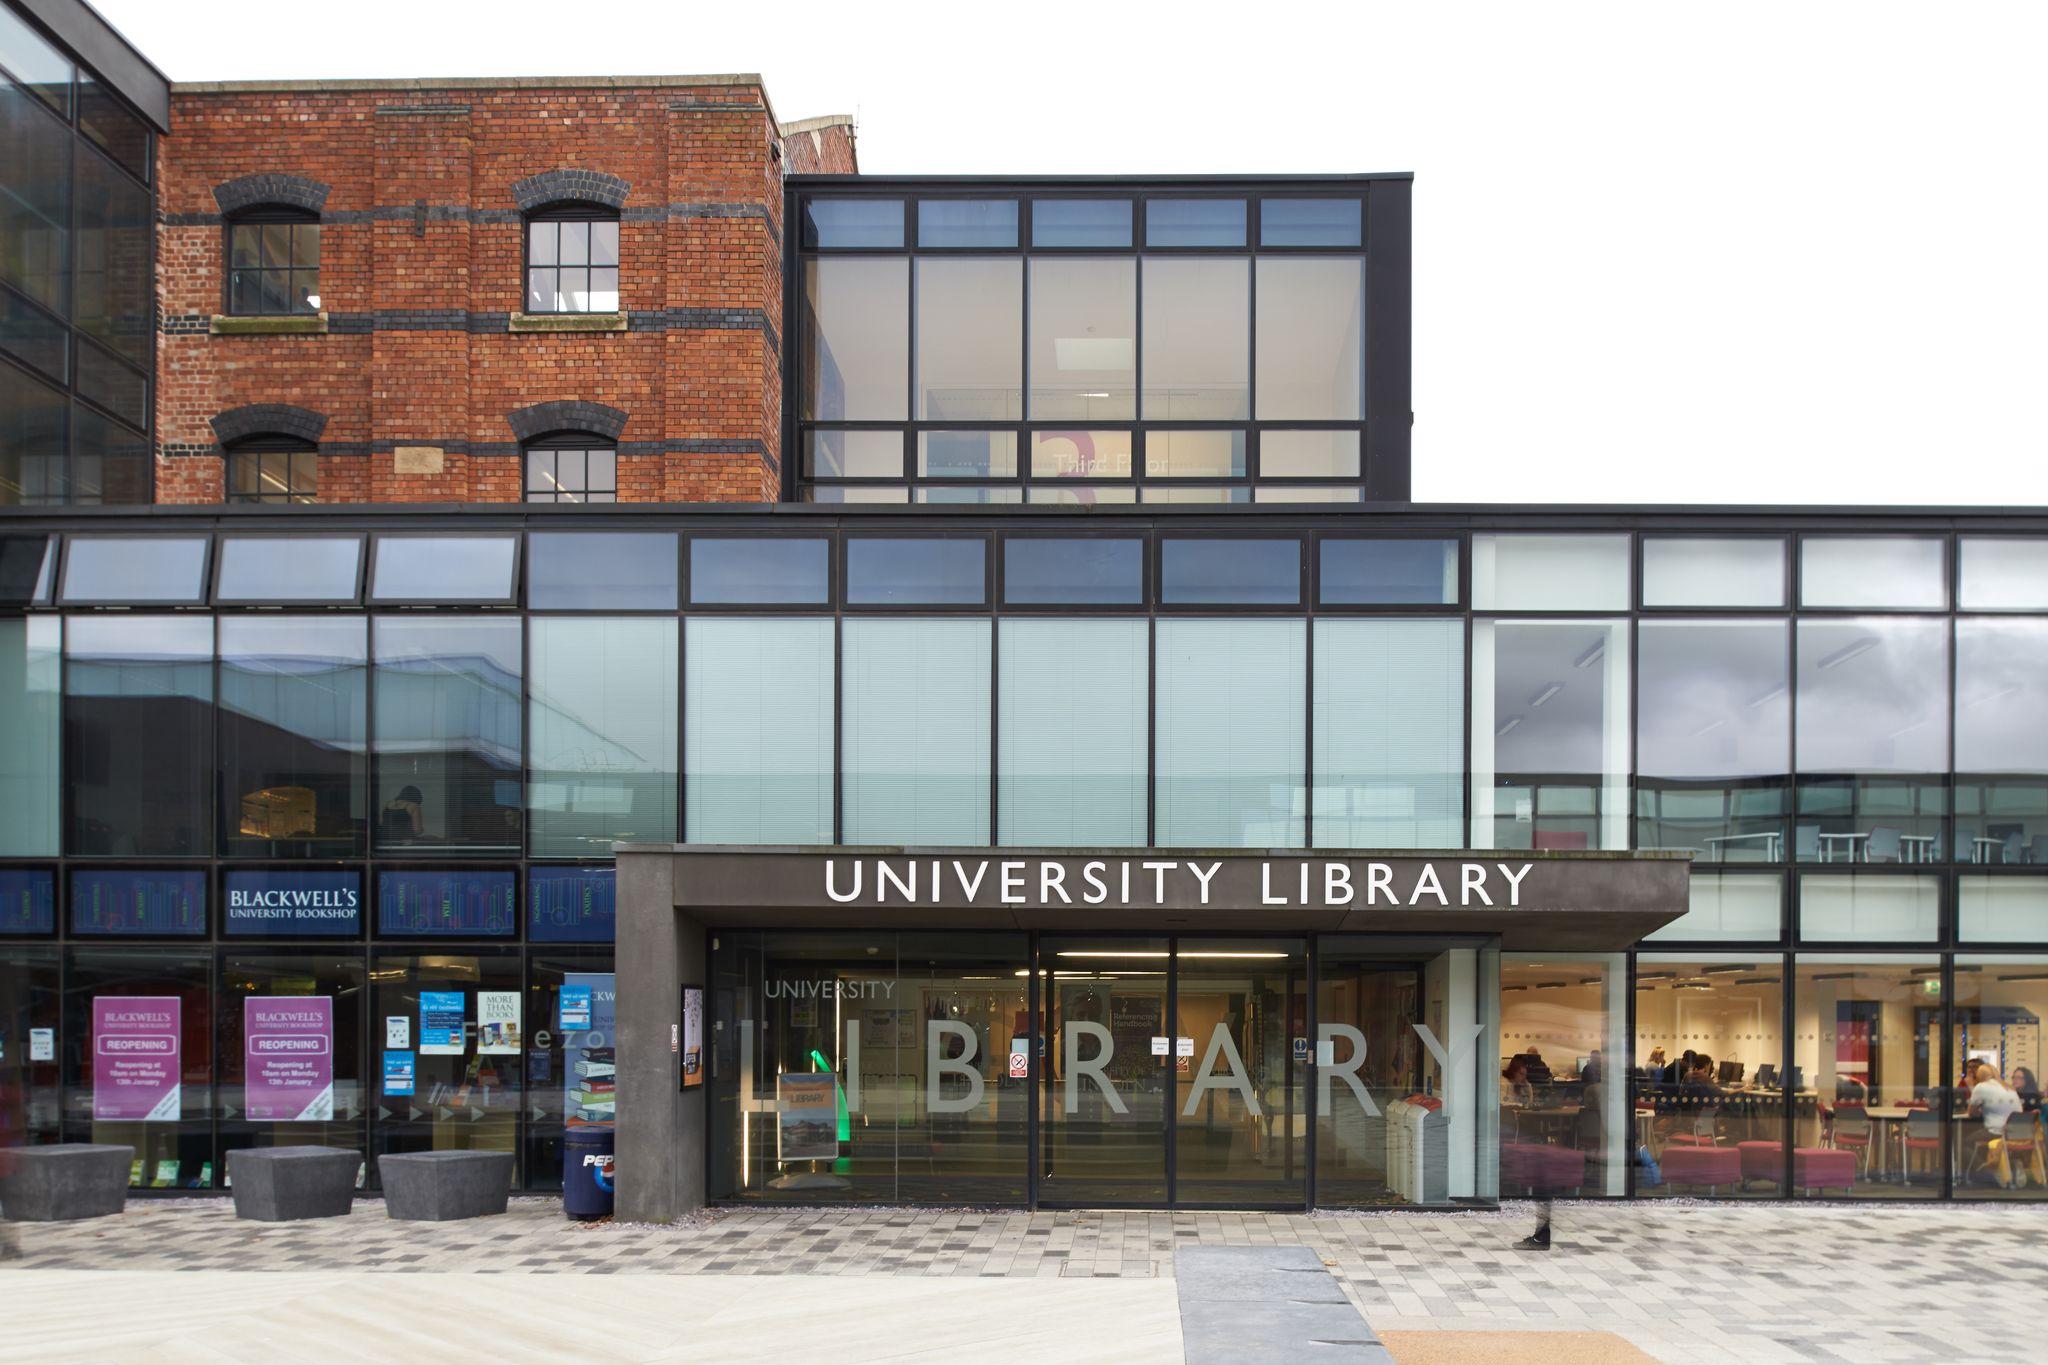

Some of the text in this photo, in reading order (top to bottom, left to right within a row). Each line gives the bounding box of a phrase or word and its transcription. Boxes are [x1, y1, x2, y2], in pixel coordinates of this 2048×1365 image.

[1053, 453, 1169, 473] Third Flor
[826, 861, 1533, 906] UNIVERSITY LIBRARY
[231, 888, 357, 907] BLACKWELL'S
[230, 909, 357, 918] UNIVERSITY BOOKSHOP
[765, 980, 896, 999] UNIVERSITY
[487, 996, 513, 1004] MORE
[104, 1012, 171, 1021] BLACKWELL'S
[256, 1012, 323, 1021] BLACKWELL'S
[107, 1040, 167, 1049] REOPENING
[259, 1040, 319, 1049] REOPENING
[115, 1061, 152, 1069] Reopening
[267, 1061, 304, 1069] Reopening
[740, 1020, 1485, 1116] LIBRARY
[139, 1070, 167, 1078] Monday
[291, 1070, 319, 1078] Monday
[583, 1154, 614, 1167] PEP
